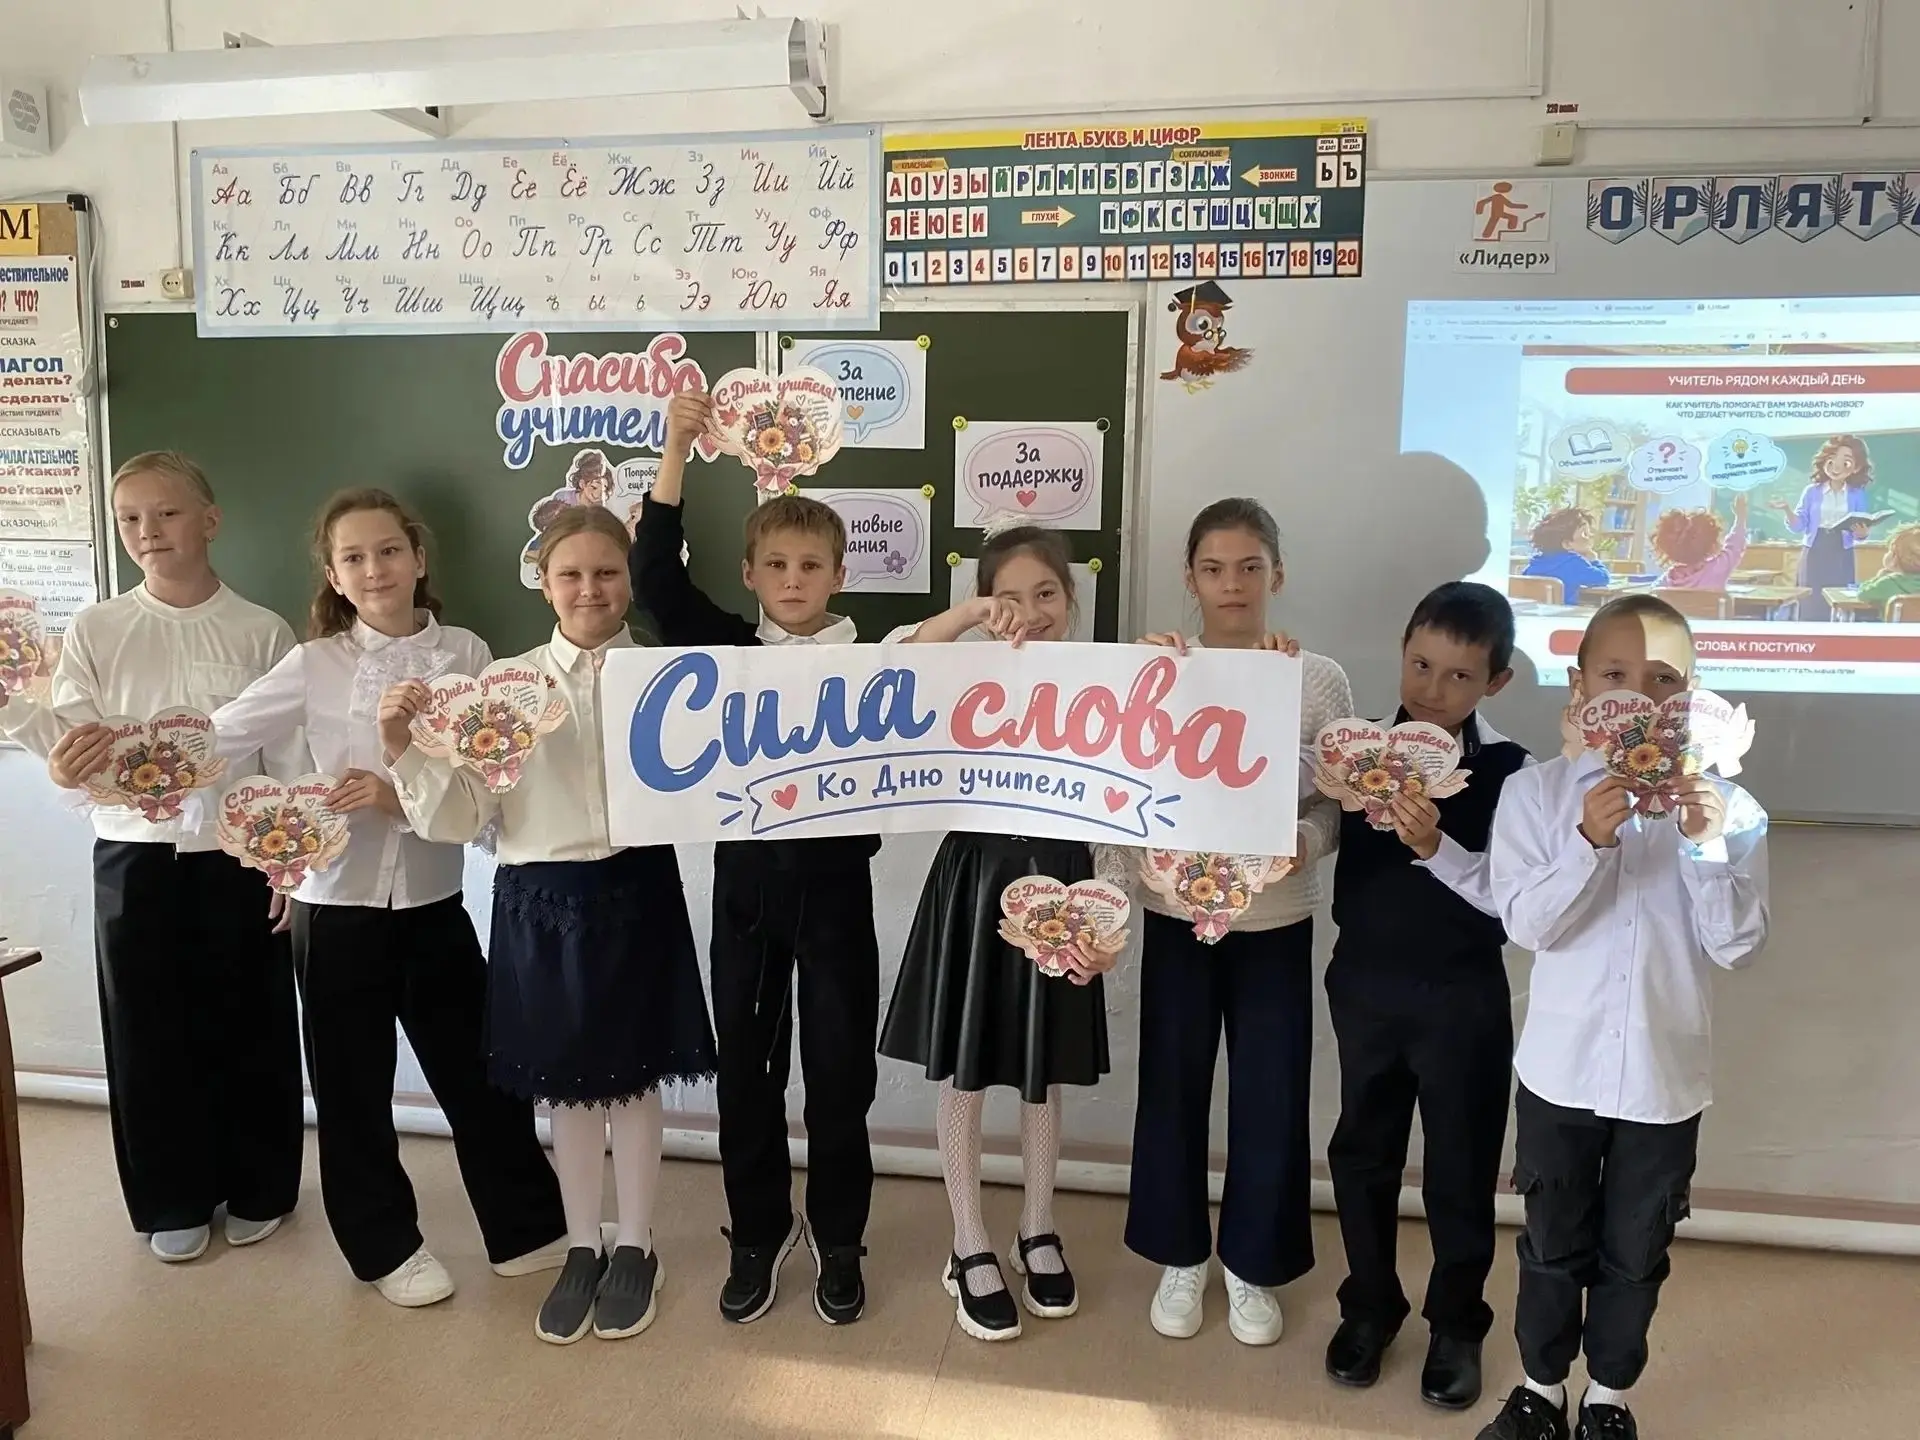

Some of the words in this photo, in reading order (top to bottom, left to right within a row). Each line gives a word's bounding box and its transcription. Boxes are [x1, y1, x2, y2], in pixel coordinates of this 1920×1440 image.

[1023, 131, 1077, 149] ЛЕНТА
[1082, 130, 1128, 146] БУКВ
[1132, 130, 1145, 145] И
[1150, 127, 1201, 146] ЦИФР
[1179, 150, 1223, 158] СОГЛАСНЫЕ
[1260, 171, 1296, 180] ЗВОНКИЕ
[1600, 181, 1920, 230] ОРЛЯТ
[0, 208, 32, 240] М
[1031, 212, 1060, 222] ГЛУХИЕ
[888, 261, 898, 277] 0
[911, 260, 918, 276] 1
[932, 259, 941, 275] 2
[953, 259, 963, 275] 3
[974, 258, 985, 274] 4
[997, 257, 1007, 273] 5
[1019, 256, 1028, 273] 6
[1041, 256, 1051, 272] 7
[1063, 255, 1073, 271] 8
[1086, 255, 1096, 271] 9
[1105, 255, 1121, 271] 10
[1130, 254, 1145, 271] 11
[1151, 253, 1169, 270] 12
[1174, 252, 1192, 269] 13
[1198, 251, 1216, 268] 14
[1220, 251, 1238, 267] 15
[1244, 250, 1261, 267] 16
[1268, 250, 1285, 266] 17
[1291, 249, 1308, 267] 18
[1315, 248, 1333, 266] 19
[1337, 248, 1357, 266] 20
[1459, 250, 1550, 268] «Лидер»
[14, 290, 39, 312] ЧТО?
[1, 337, 36, 345] СКАЗКА
[500, 331, 705, 402] Спасибо
[838, 360, 863, 381] За
[3, 375, 73, 387] делать?
[716, 388, 729, 405] С
[731, 379, 771, 400] Днём
[777, 377, 836, 400] учителя!
[1669, 375, 1723, 386] УЧИТЕЛЬ
[1726, 375, 1769, 387] РЯДОМ
[1772, 373, 1829, 387] КАЖДЫЙ
[1832, 375, 1865, 386] ДЕНЬ
[501, 405, 669, 466] учител
[1015, 443, 1041, 463] За
[624, 468, 659, 479] Попробу
[978, 466, 1084, 492] поддержку
[851, 513, 903, 534] новые
[1695, 641, 1736, 651] СЛОВА
[1739, 642, 1746, 651] К
[1750, 642, 1815, 653] ПОСТУПКУ
[434, 681, 475, 708] Днём
[480, 668, 540, 696] учителя!
[629, 651, 936, 793] Сила
[949, 655, 1268, 789] слова
[1582, 707, 1599, 726] С
[1602, 698, 1653, 720] Днём
[1321, 733, 1335, 748] С
[1337, 728, 1382, 744] Днём
[1387, 731, 1455, 754] учителя!
[817, 772, 856, 802] Ко
[872, 764, 943, 799] Дню
[959, 767, 1086, 802] учителя
[225, 793, 238, 808] С
[240, 784, 281, 804] Днём
[286, 783, 330, 803] учите
[1007, 886, 1020, 900] С
[1022, 882, 1063, 897] Днём
